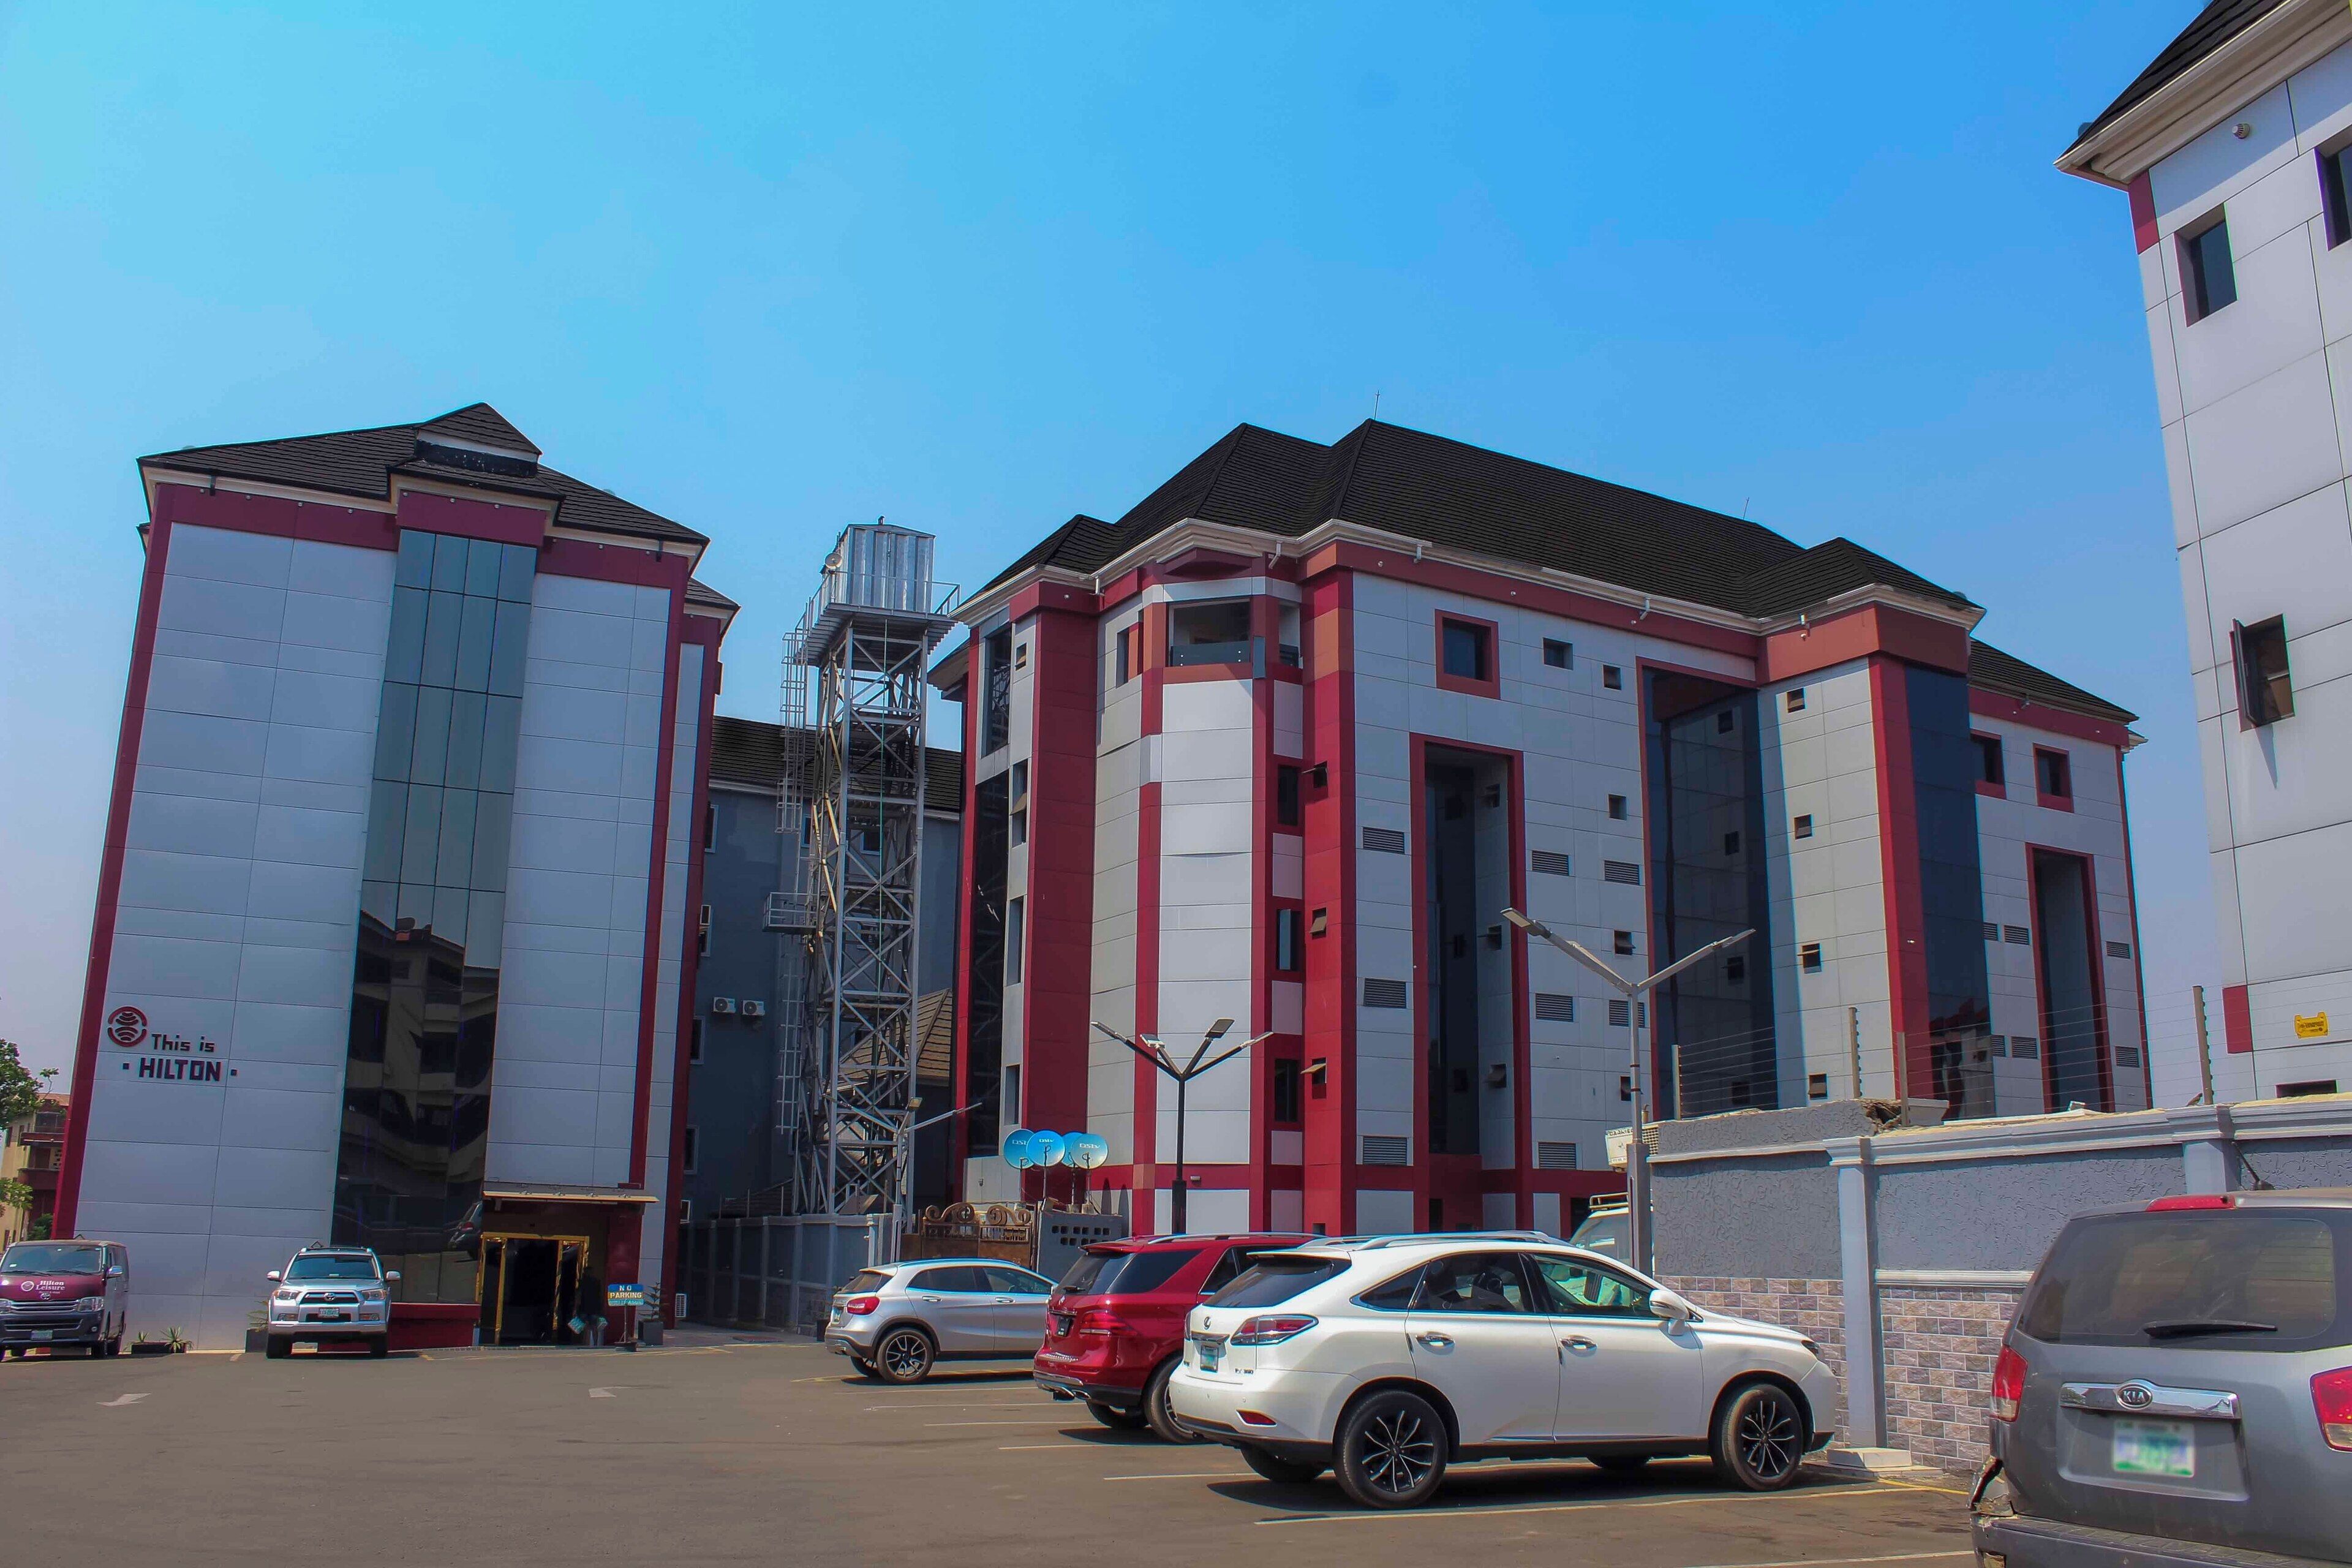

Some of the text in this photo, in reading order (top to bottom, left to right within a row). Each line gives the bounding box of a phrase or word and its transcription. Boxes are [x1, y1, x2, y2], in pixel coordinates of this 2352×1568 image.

[152, 1033, 214, 1052] This is
[139, 1057, 221, 1081] HILTON
[2122, 1390, 2146, 1403] KIA
